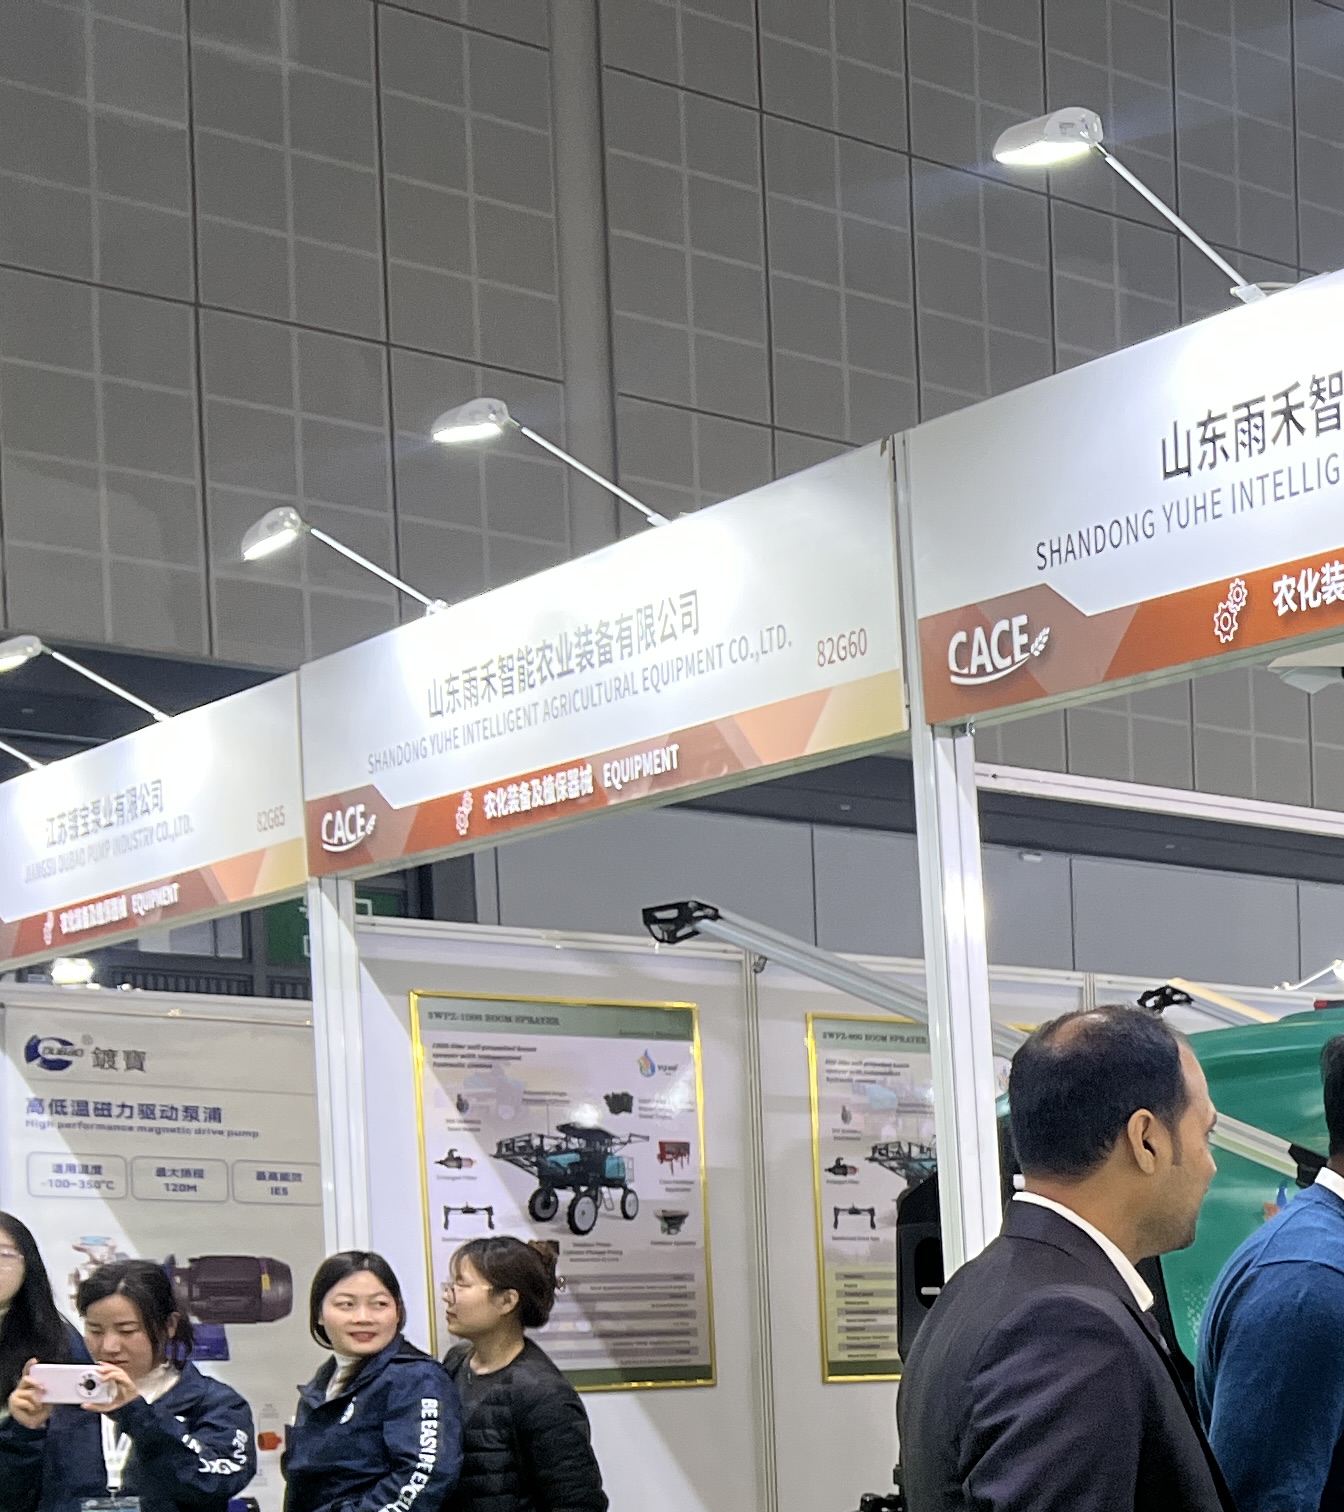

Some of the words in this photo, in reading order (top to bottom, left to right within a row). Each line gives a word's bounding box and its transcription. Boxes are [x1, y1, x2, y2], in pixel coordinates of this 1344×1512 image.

[1035, 508, 1156, 572] SHANDONG
[1161, 487, 1224, 535] YUHE
[428, 589, 700, 718] 山东雨禾智能农业装备有限公司
[816, 627, 868, 668] 82G60
[947, 613, 1031, 679] CACE
[367, 737, 428, 774] SHANDONG
[429, 726, 460, 755] YUHE
[462, 701, 540, 747] INTELLIGENT
[542, 671, 639, 724] AGRICULTURAL
[642, 642, 725, 694] EQUIPMENT
[729, 623, 792, 665] CO.,LTD.
[603, 743, 680, 791] EQUIPMENT
[321, 802, 366, 847] CACE
[25, 1119, 54, 1131] High
[57, 1120, 134, 1133] performance
[136, 1124, 191, 1138] magnetic
[194, 1126, 225, 1137] drive
[227, 1129, 259, 1140] pump
[421, 1398, 438, 1419] BE
